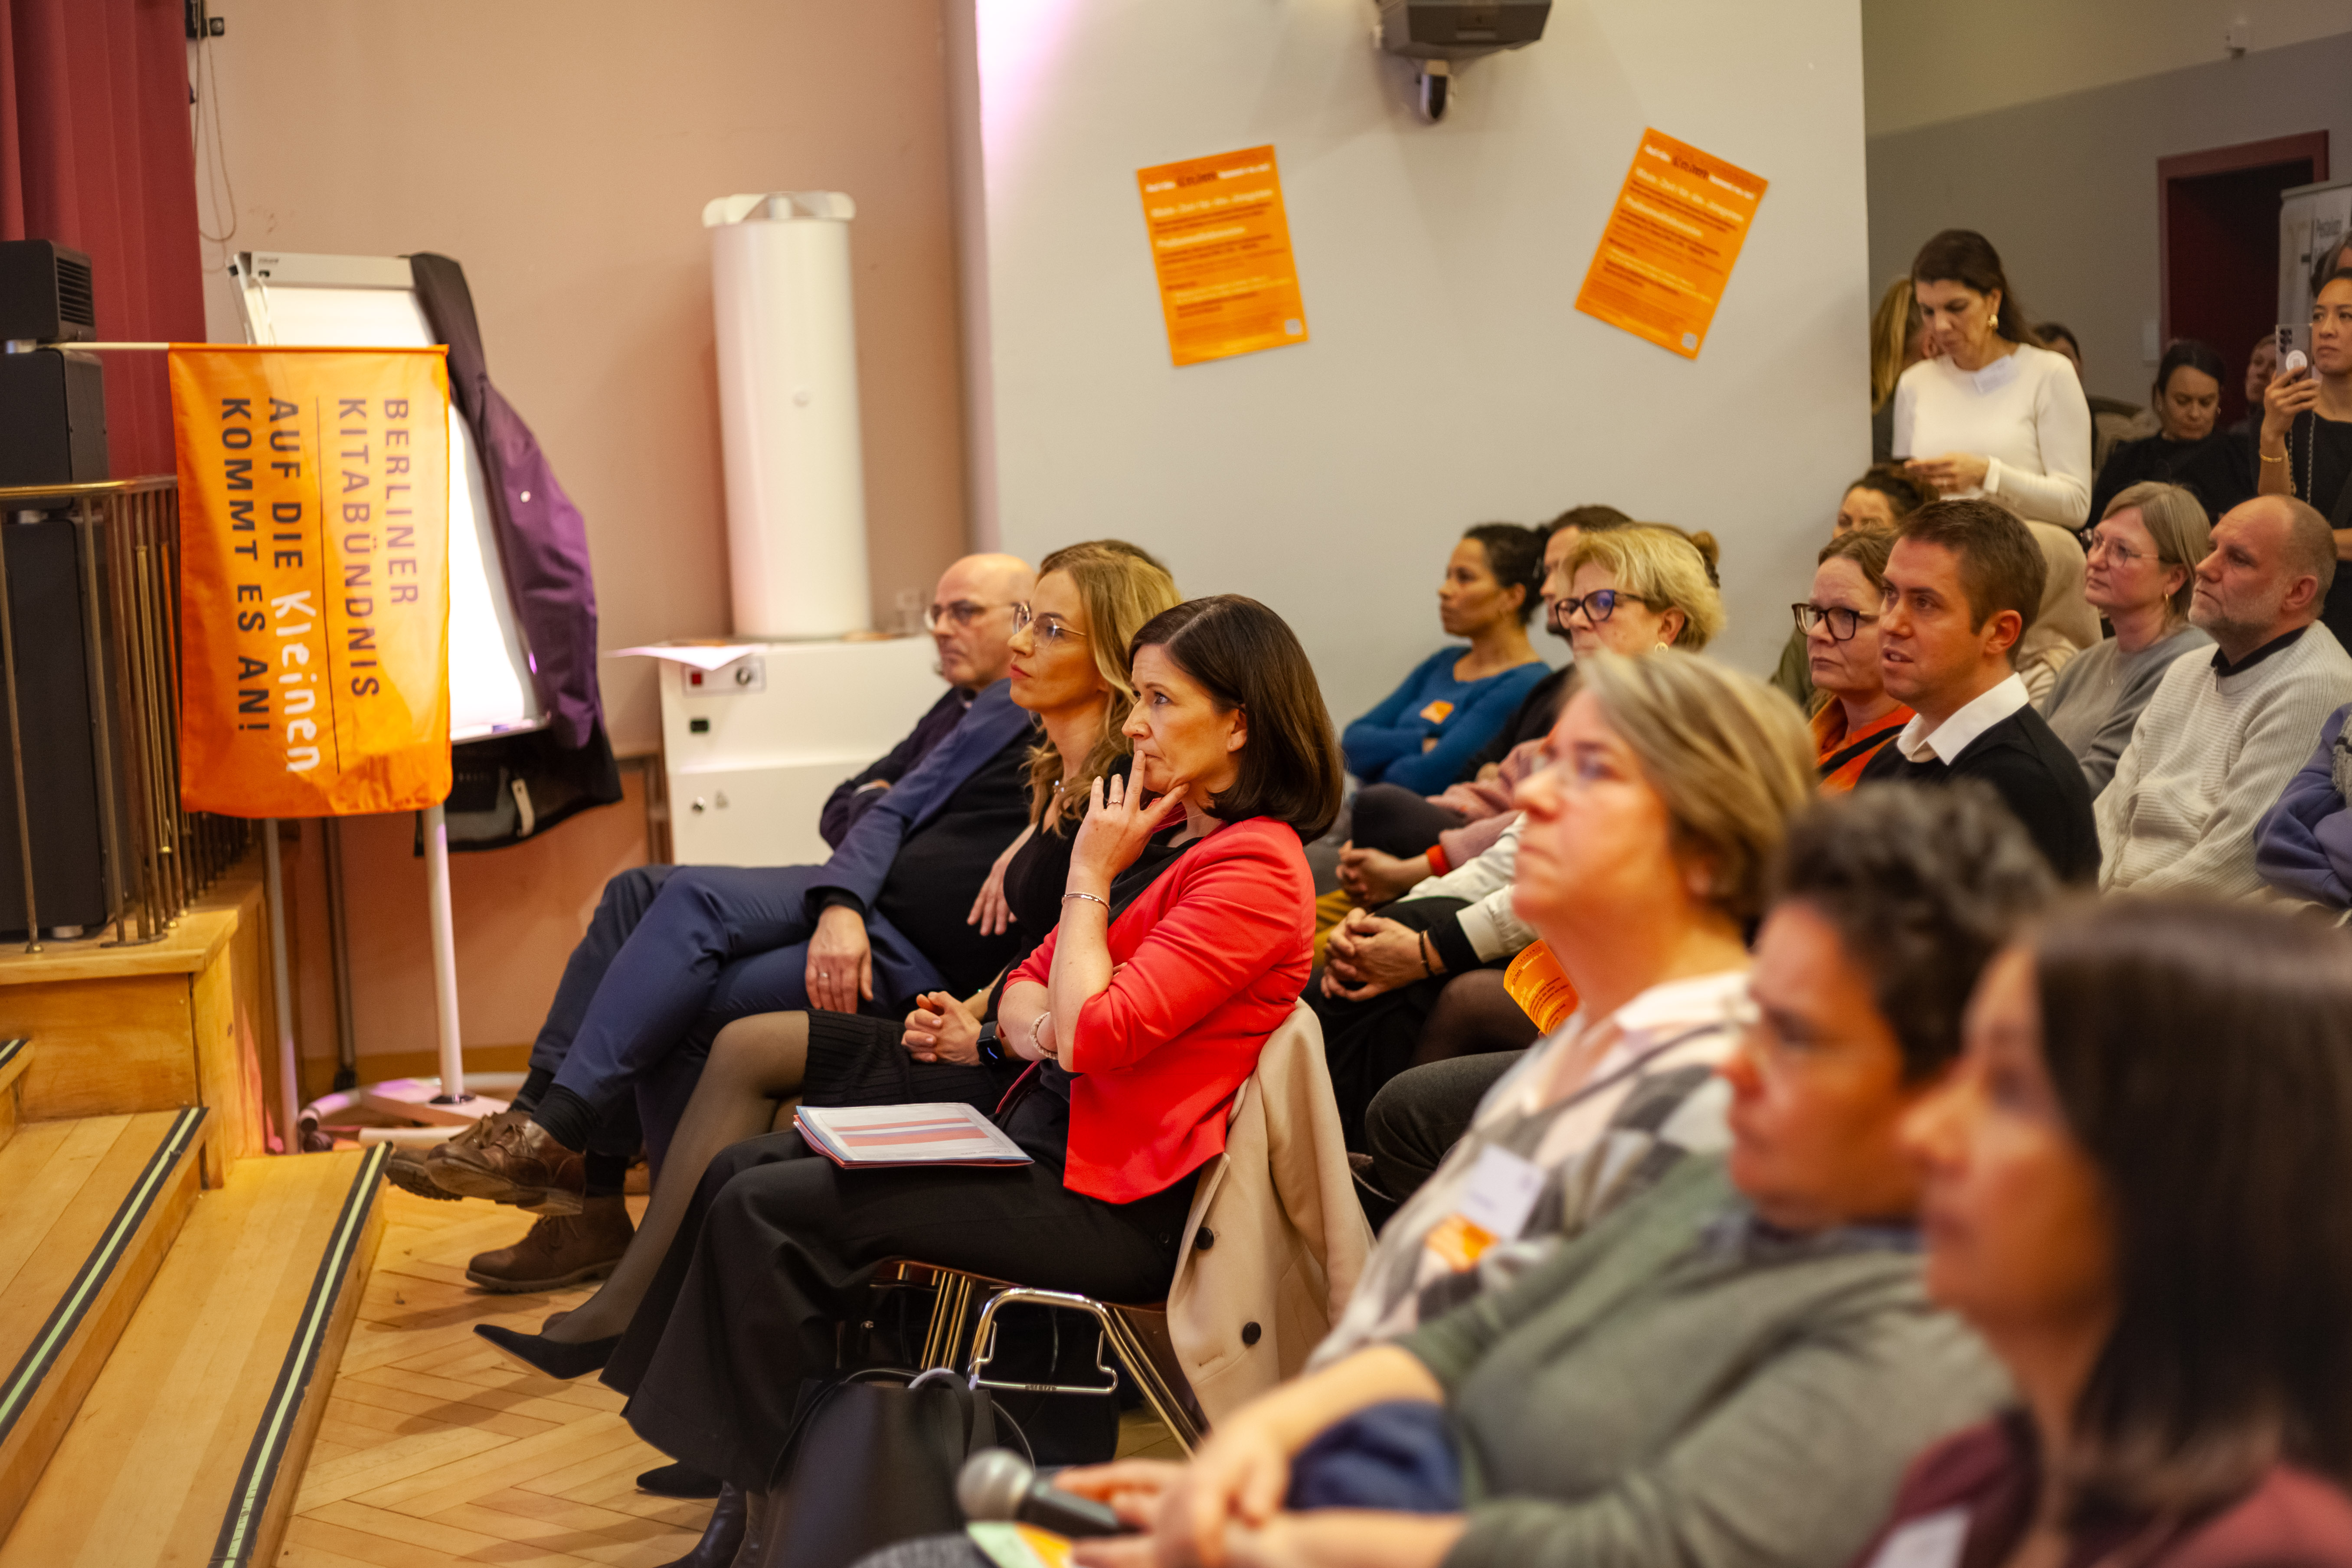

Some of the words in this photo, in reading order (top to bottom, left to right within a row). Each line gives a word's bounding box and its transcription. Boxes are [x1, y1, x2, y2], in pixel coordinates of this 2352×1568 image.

[222, 398, 259, 560] KOMMT
[268, 396, 301, 479] AUF
[272, 502, 303, 569] DIE
[339, 398, 379, 697] KITABÜNDNIS
[384, 398, 419, 604] BERLINER
[237, 585, 265, 632] ES
[238, 656, 270, 731] AN!
[271, 590, 320, 773] Kleinen
